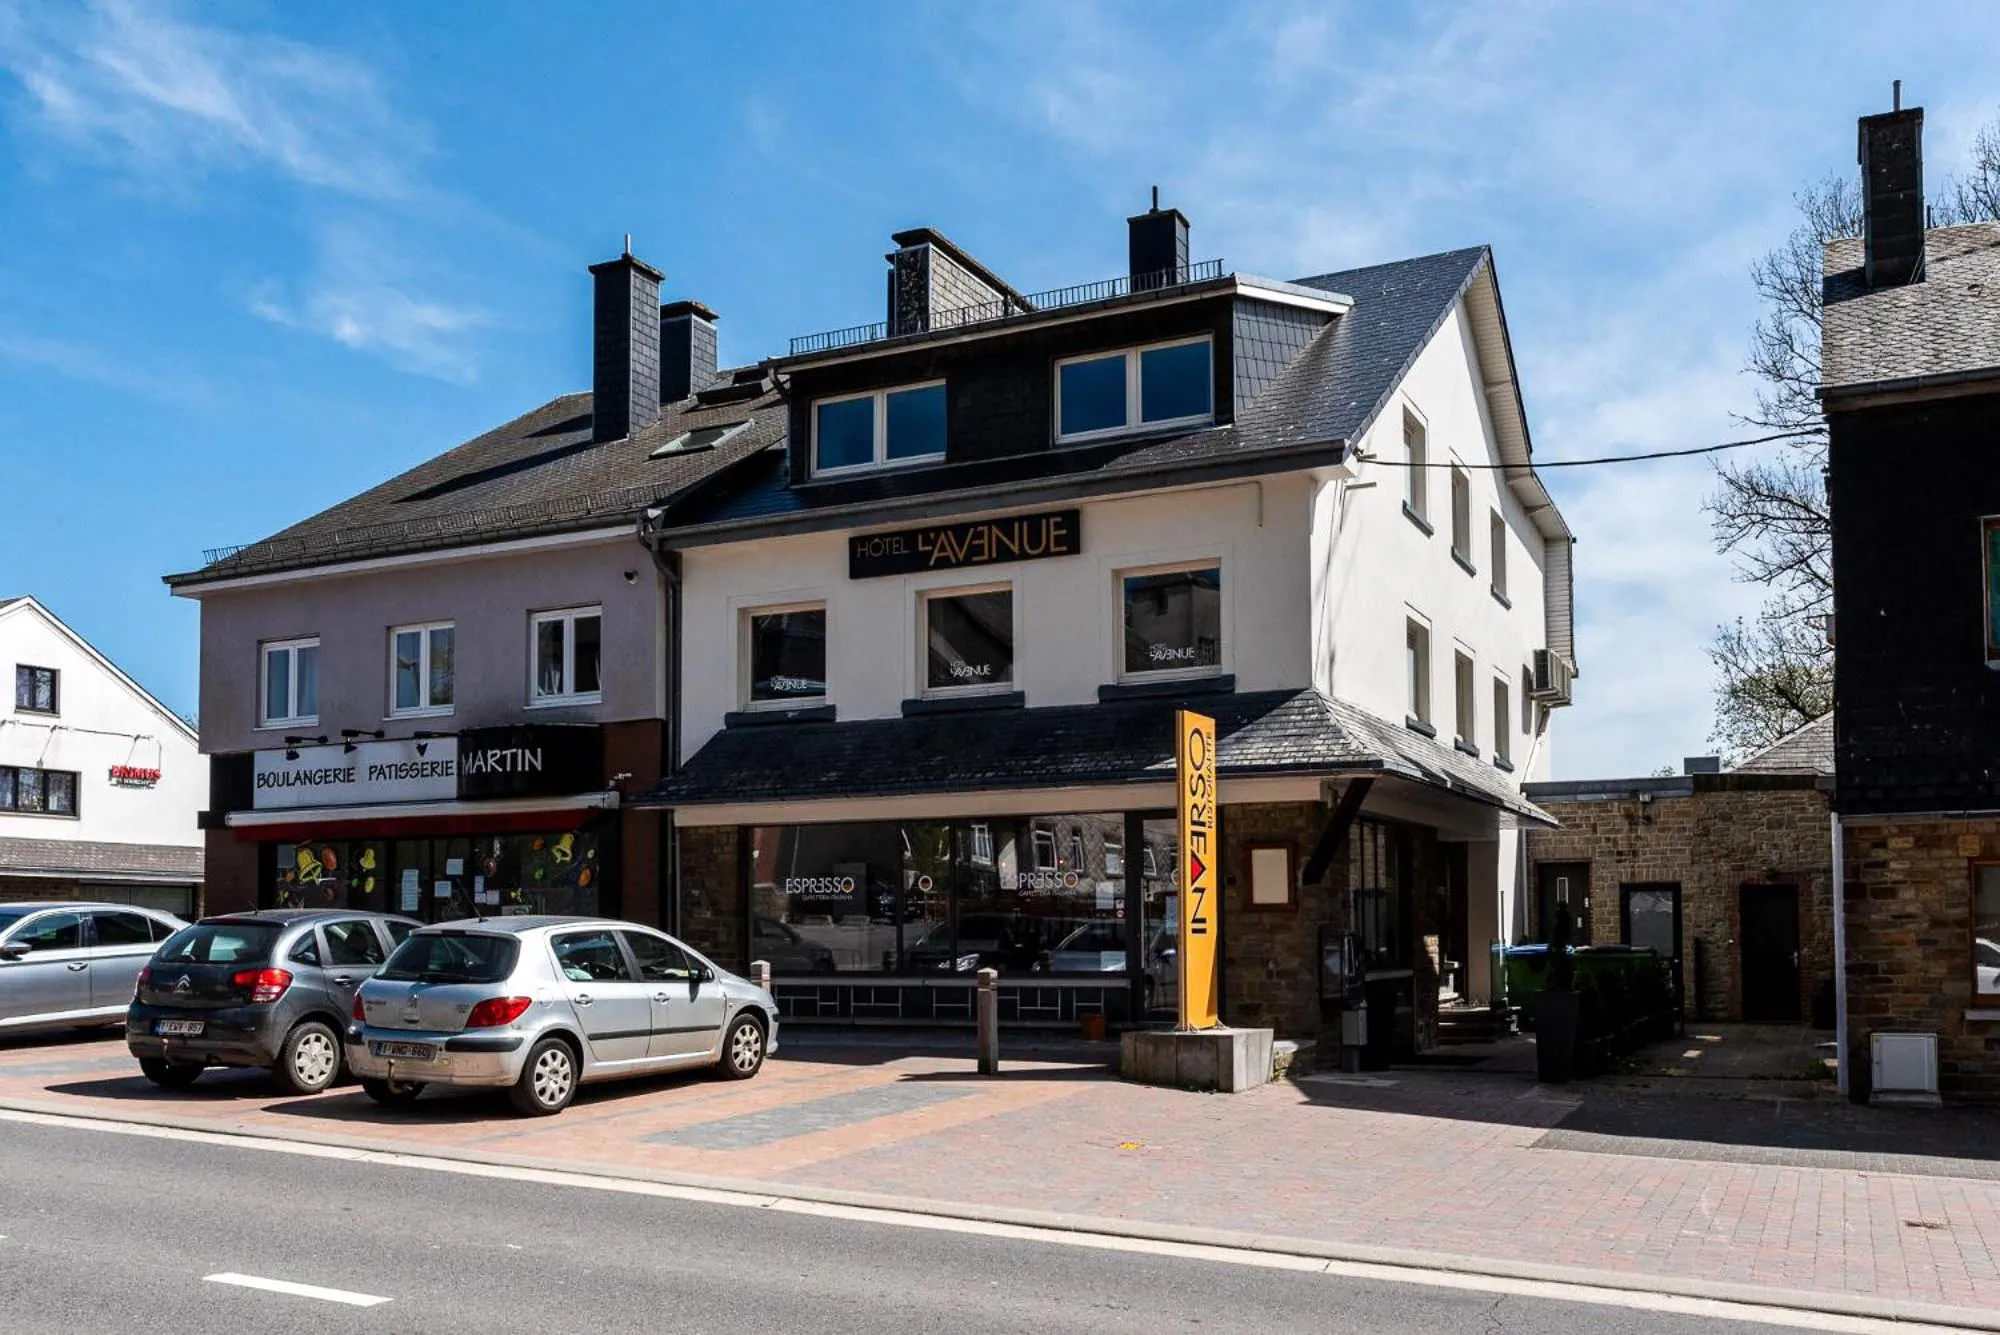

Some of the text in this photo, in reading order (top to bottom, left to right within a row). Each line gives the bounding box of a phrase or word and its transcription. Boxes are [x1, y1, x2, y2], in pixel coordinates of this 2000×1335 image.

[856, 517, 1068, 567] HÔTEL L'AVENUE
[257, 748, 542, 788] BOULANGERIE PATISSERIE MARTIN
[785, 876, 855, 894] ESPRESSO
